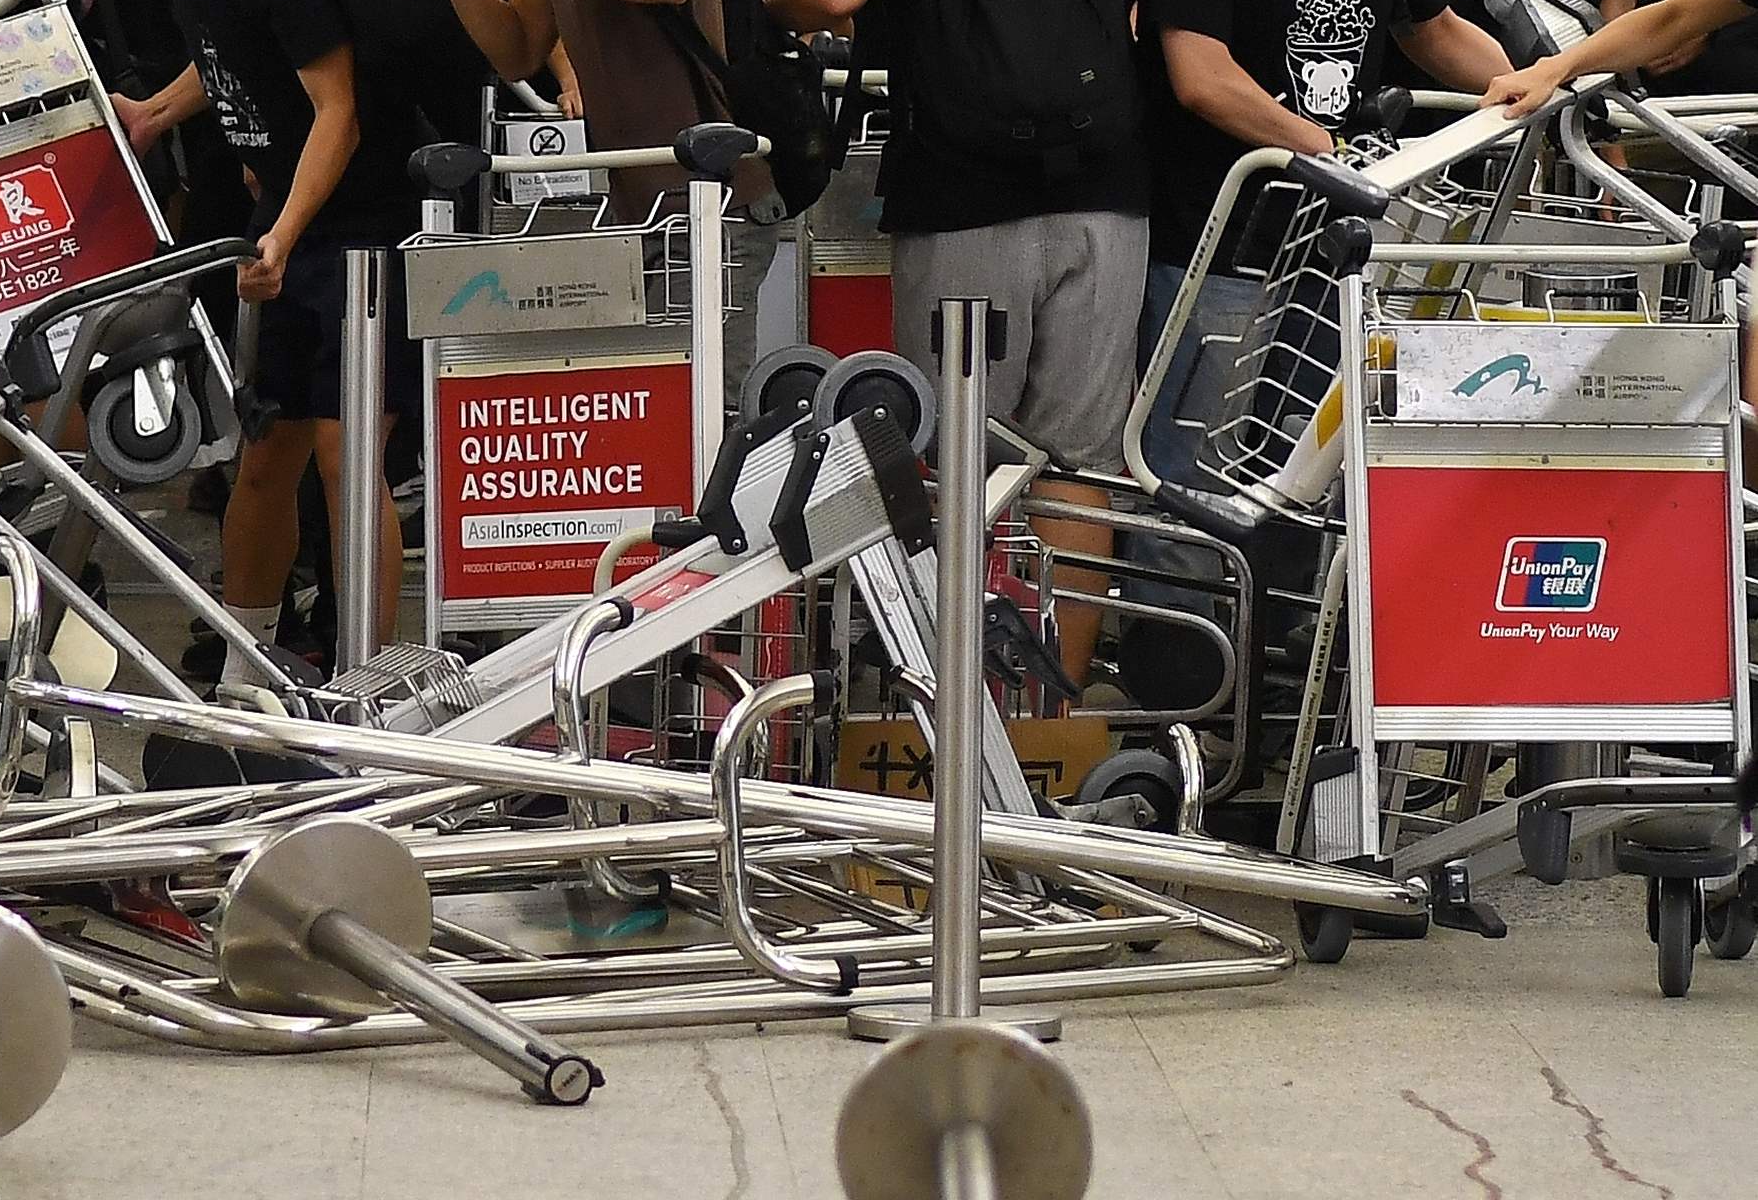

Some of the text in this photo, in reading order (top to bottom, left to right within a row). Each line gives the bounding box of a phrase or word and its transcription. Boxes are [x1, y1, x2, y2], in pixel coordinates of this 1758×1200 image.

[518, 173, 583, 186] No Etradition
[1612, 375, 1665, 383] HONG KONG
[460, 391, 650, 429] INTELLIGENT
[460, 430, 589, 465] QUALITY
[461, 464, 643, 501] ASSURANCE
[463, 563, 492, 573] PRODUCT
[494, 561, 536, 572] INSPECTIONS
[545, 559, 577, 570] SUPPLIER
[1511, 556, 1594, 582] UnionPay
[1481, 623, 1620, 644] UnionPay Your Way
